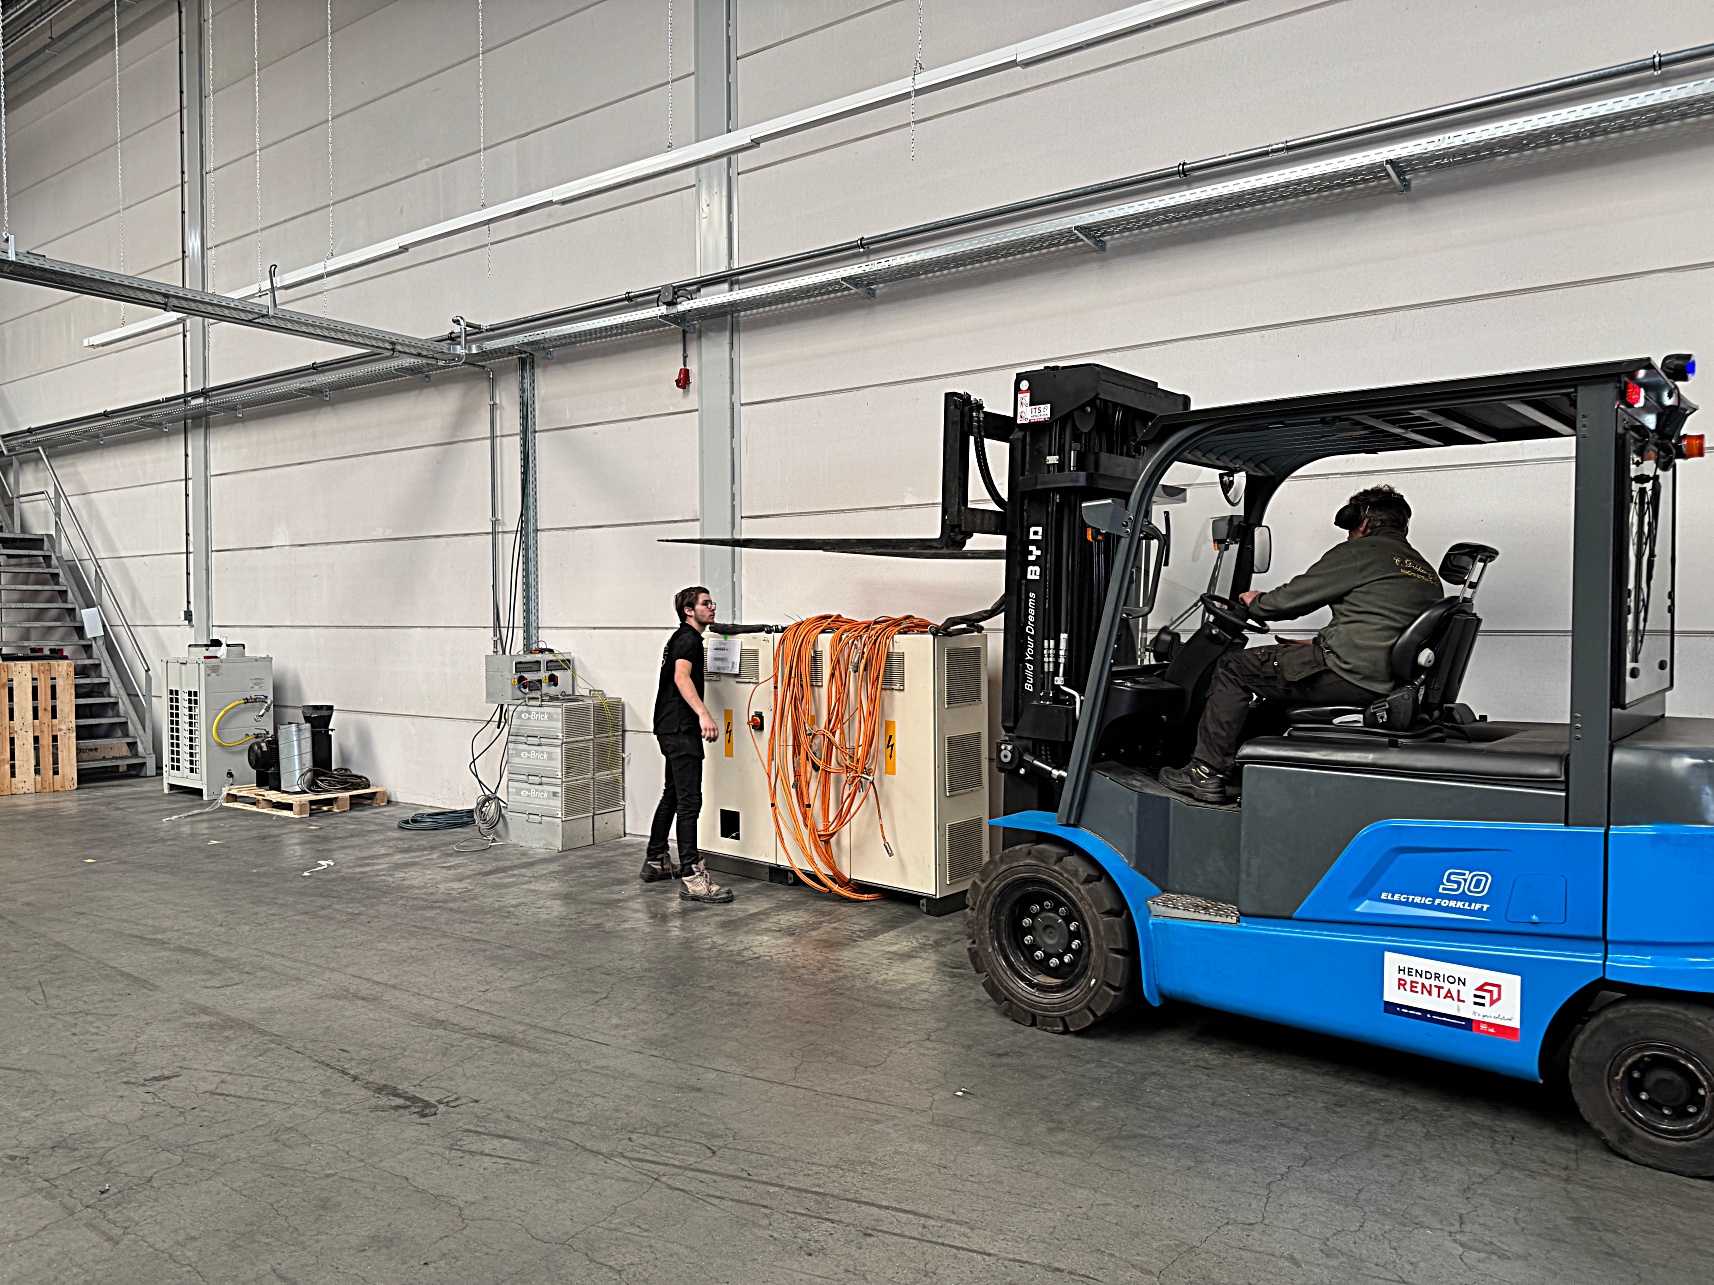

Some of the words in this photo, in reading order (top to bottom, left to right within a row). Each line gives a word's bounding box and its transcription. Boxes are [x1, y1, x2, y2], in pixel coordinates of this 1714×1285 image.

[1030, 406, 1042, 415] ITS
[1026, 526, 1043, 580] BYD
[1025, 592, 1036, 635] Dreams
[1024, 637, 1035, 662] Your
[1024, 663, 1034, 692] Build
[521, 711, 549, 721] e-Brick
[520, 750, 548, 760] e-Brick
[520, 789, 548, 799] e-Brick
[1380, 892, 1433, 905] ELECTRIC
[1434, 898, 1490, 912] FORKLIFT
[1397, 965, 1467, 987] HENDRION
[1397, 977, 1466, 1004] RENTAL
